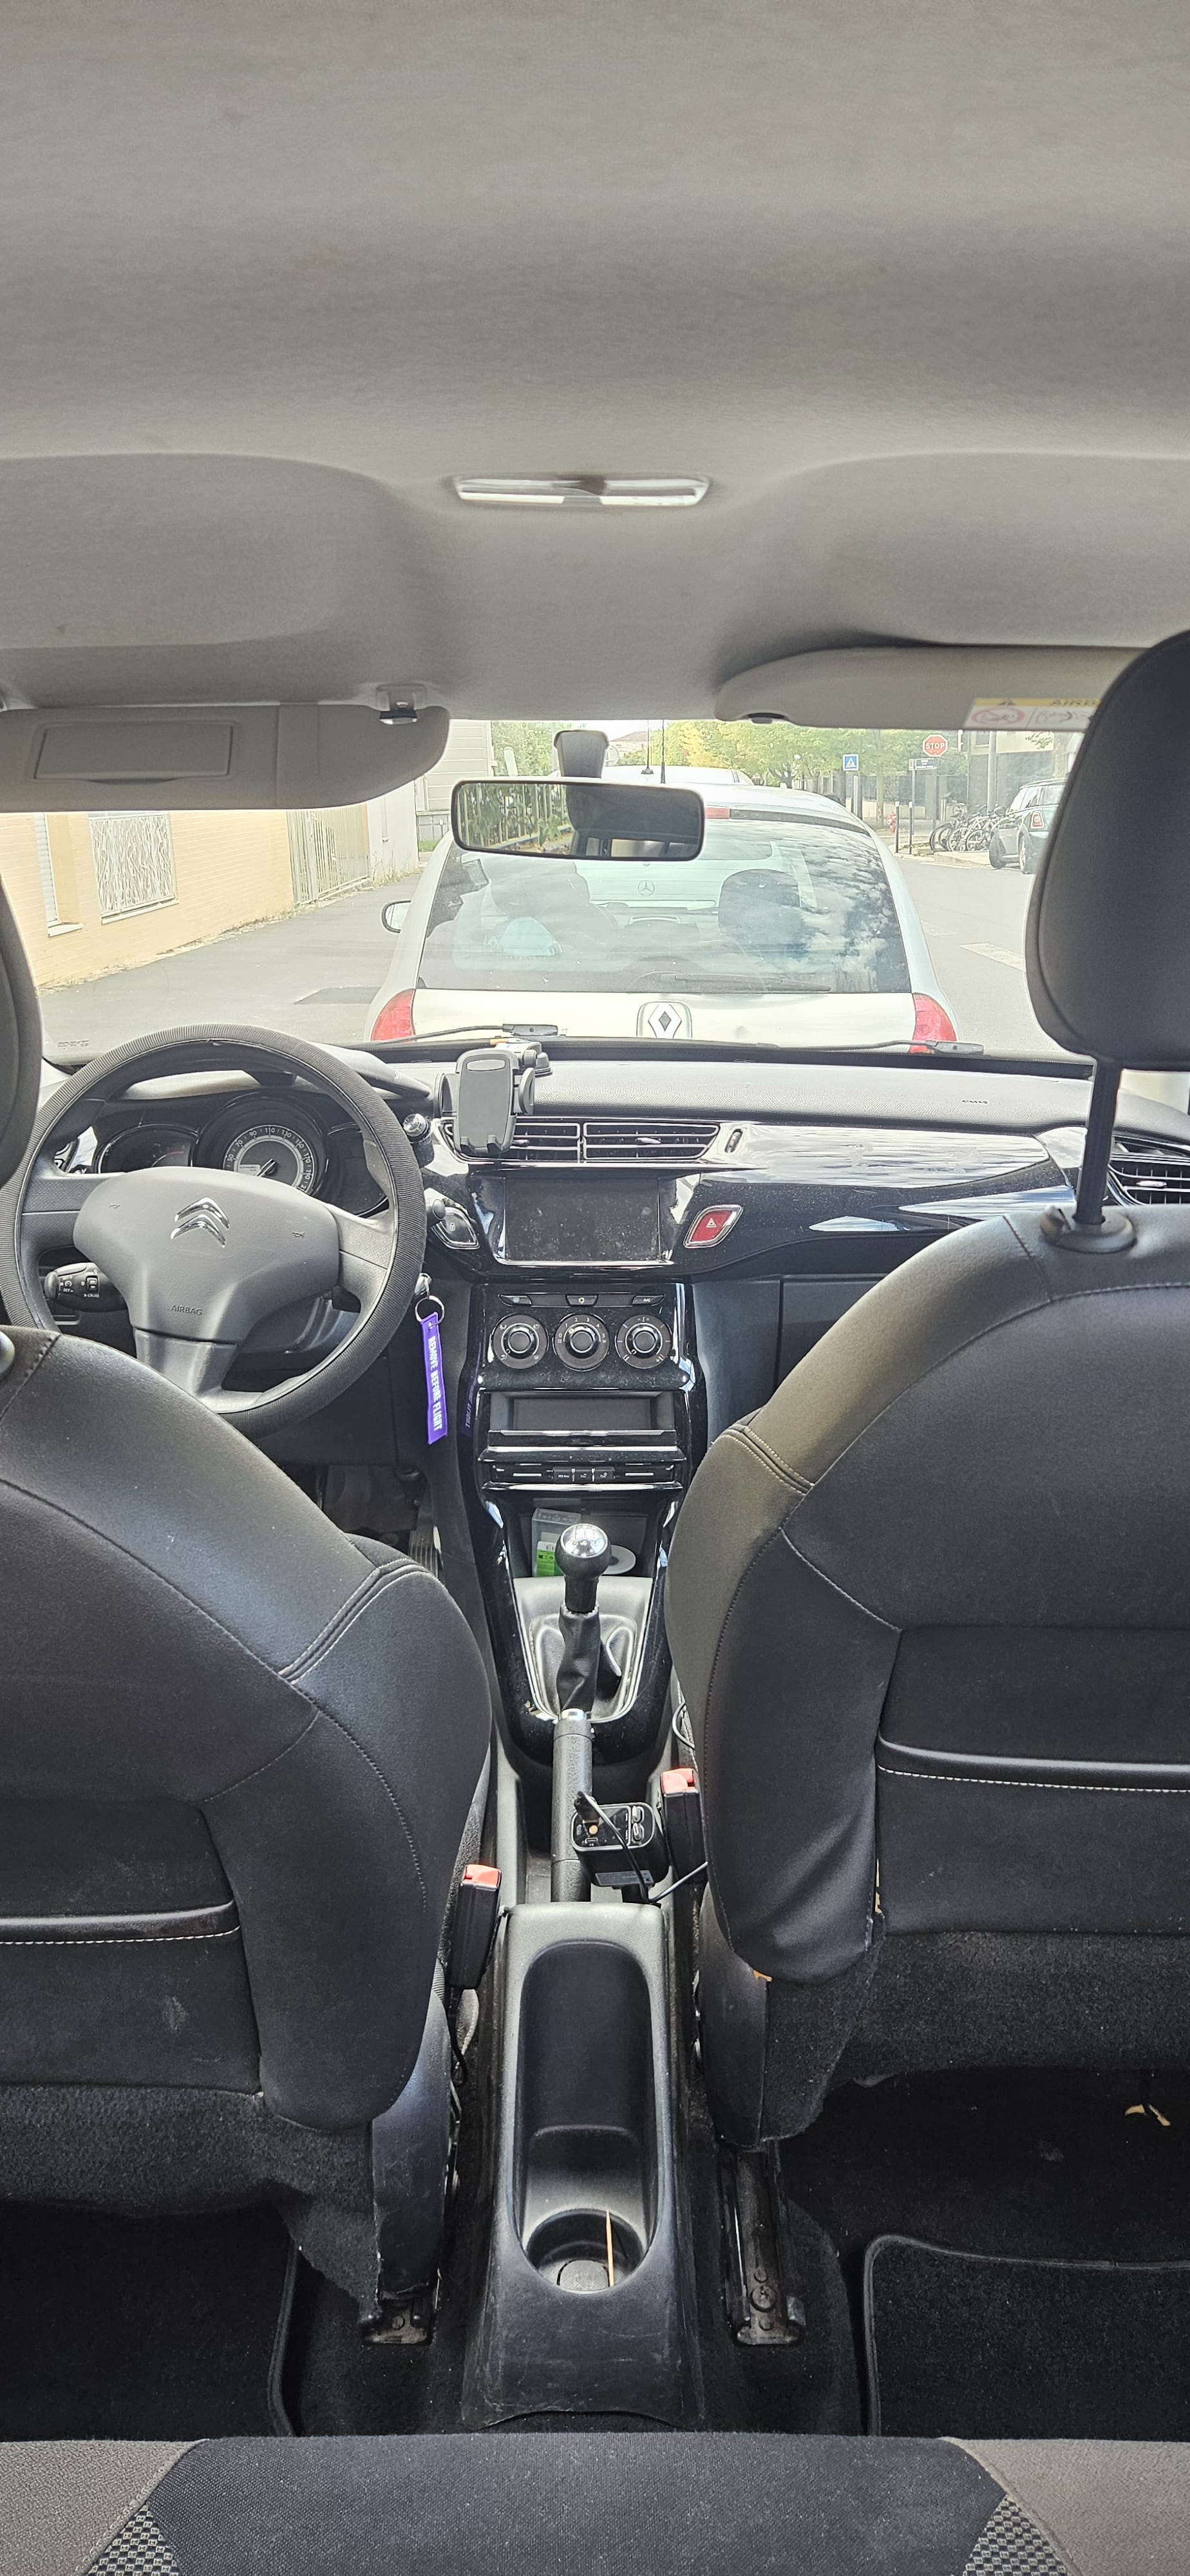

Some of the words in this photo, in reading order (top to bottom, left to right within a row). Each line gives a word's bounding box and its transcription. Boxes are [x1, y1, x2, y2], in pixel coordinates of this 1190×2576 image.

[281, 1130, 292, 1138] 130
[236, 1139, 243, 1148] 70
[296, 1139, 305, 1149] 150
[171, 1305, 203, 1315] AIRBAG
[428, 1336, 439, 1371] REMOVE
[430, 1370, 442, 1403] BEFORE
[432, 1401, 443, 1432] FLIGHT
